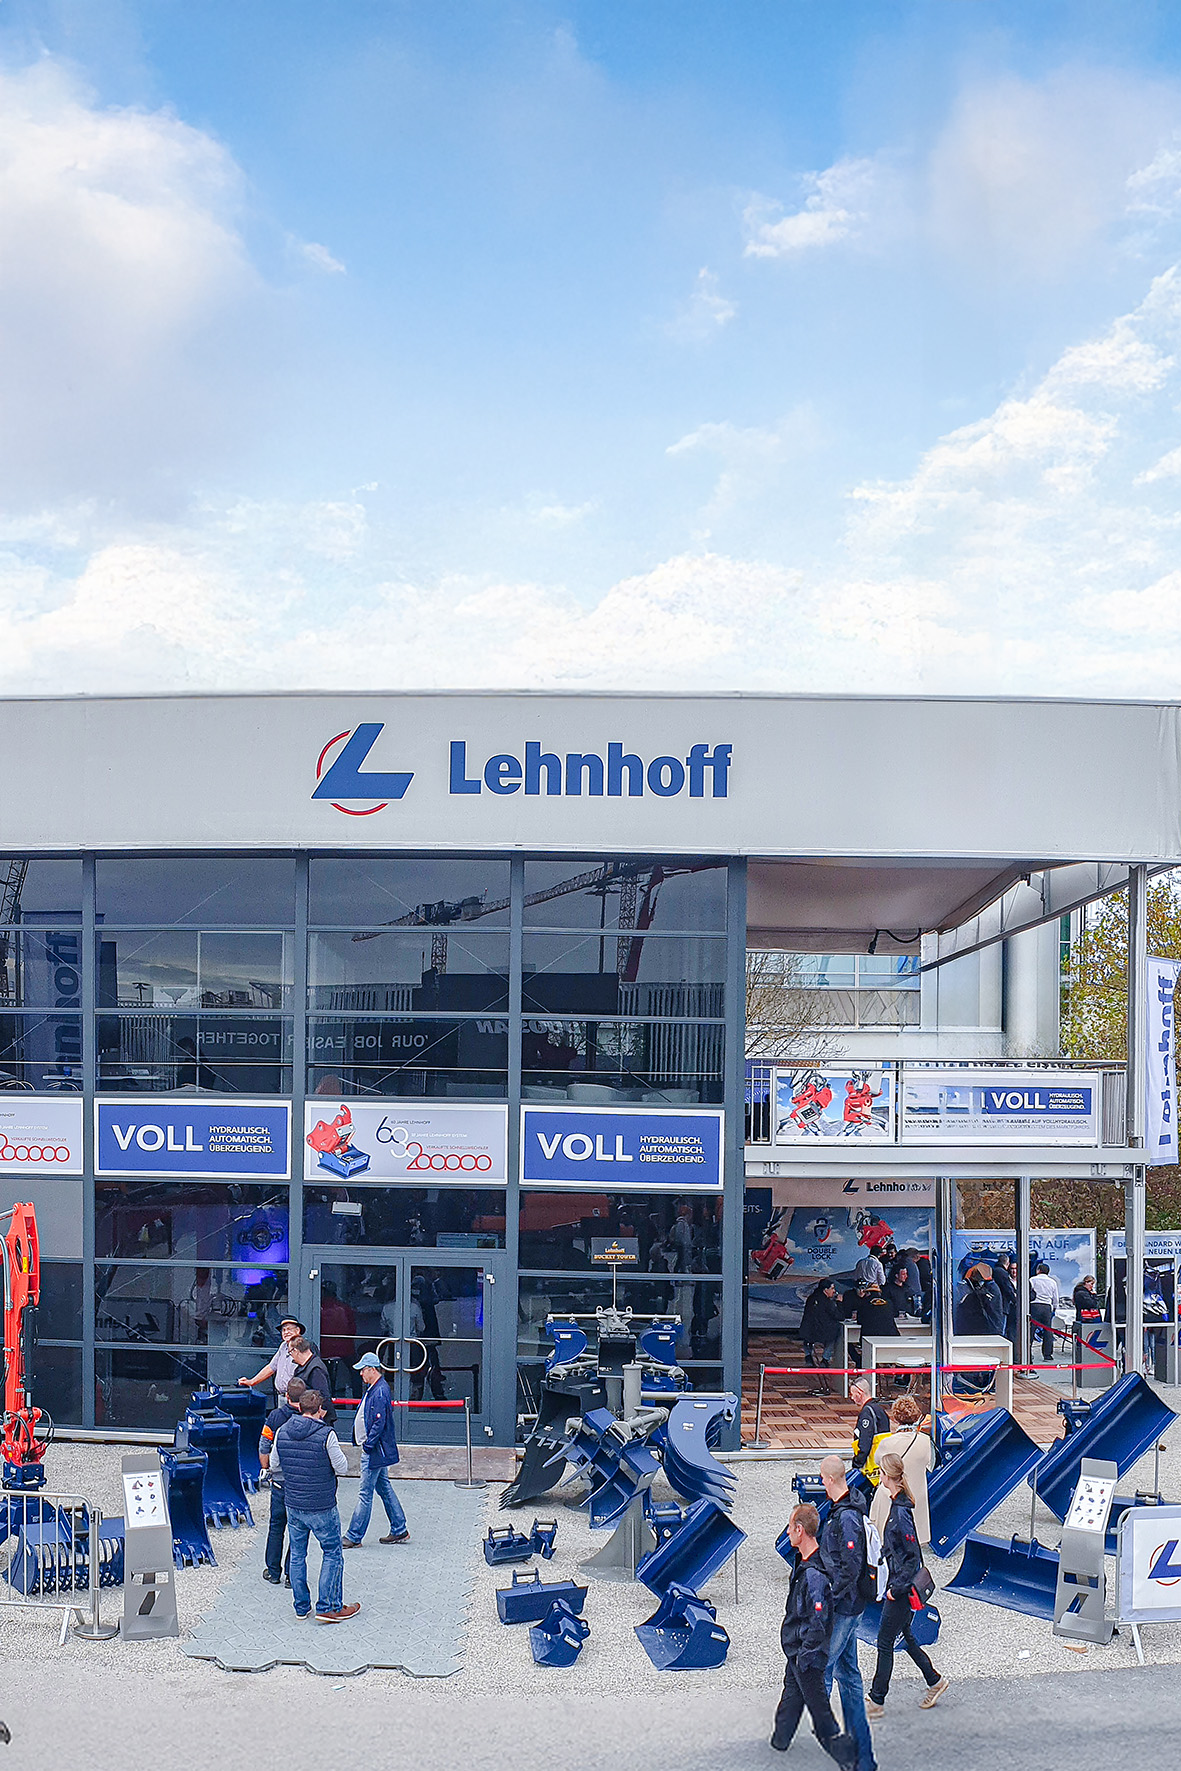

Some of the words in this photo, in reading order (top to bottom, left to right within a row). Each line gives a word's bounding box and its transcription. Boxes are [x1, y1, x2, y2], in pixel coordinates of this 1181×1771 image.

[449, 740, 733, 798] Lehnhoff
[991, 1092, 1047, 1109] VOLL
[209, 1126, 270, 1135] HYDRAULISCH.
[111, 1124, 203, 1152] VOLL
[209, 1135, 273, 1144] AUTOMATISCH.
[640, 1136, 702, 1145] HYDRAULISCH.
[209, 1143, 275, 1153] ÜBERZEUGEND.
[536, 1132, 634, 1162] VOLL
[640, 1145, 705, 1154] AUTOMATISCH.
[640, 1153, 706, 1164] ÜBERZEUGEND.
[1046, 1240, 1070, 1249] AUF
